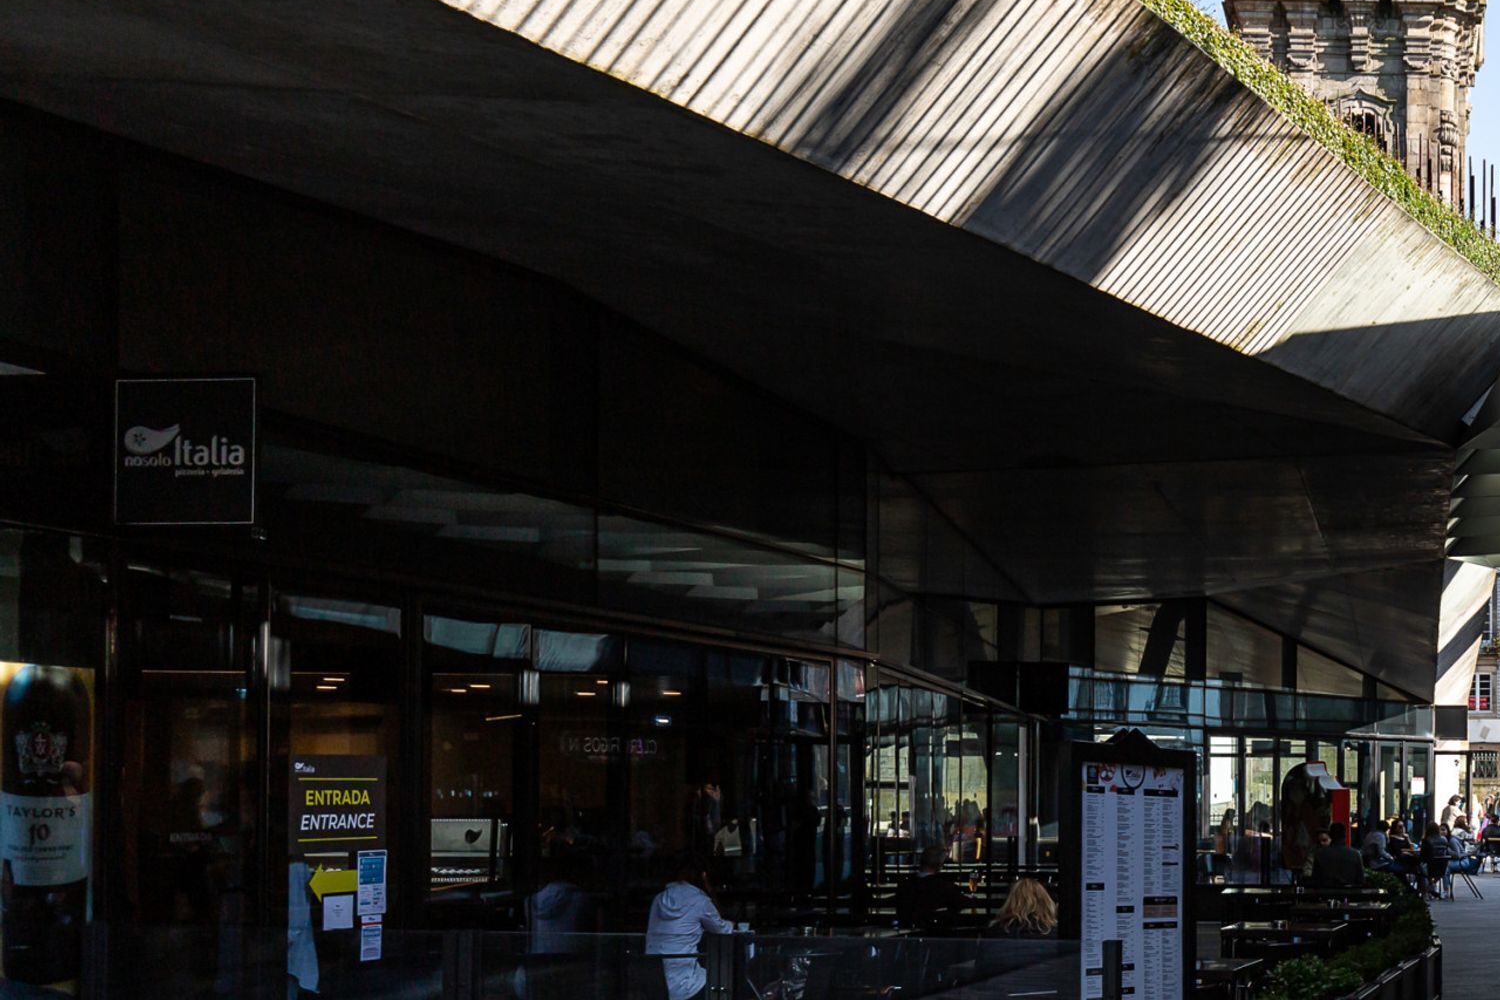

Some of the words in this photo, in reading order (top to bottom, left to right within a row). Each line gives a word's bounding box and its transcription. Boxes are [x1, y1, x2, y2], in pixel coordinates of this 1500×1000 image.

[124, 452, 172, 467] nosolo
[174, 434, 245, 467] Italia
[305, 789, 371, 806] ENTRADA
[7, 805, 77, 820] TAYLOR'S
[300, 812, 375, 831] ENTRANCE
[28, 824, 50, 846] 10
